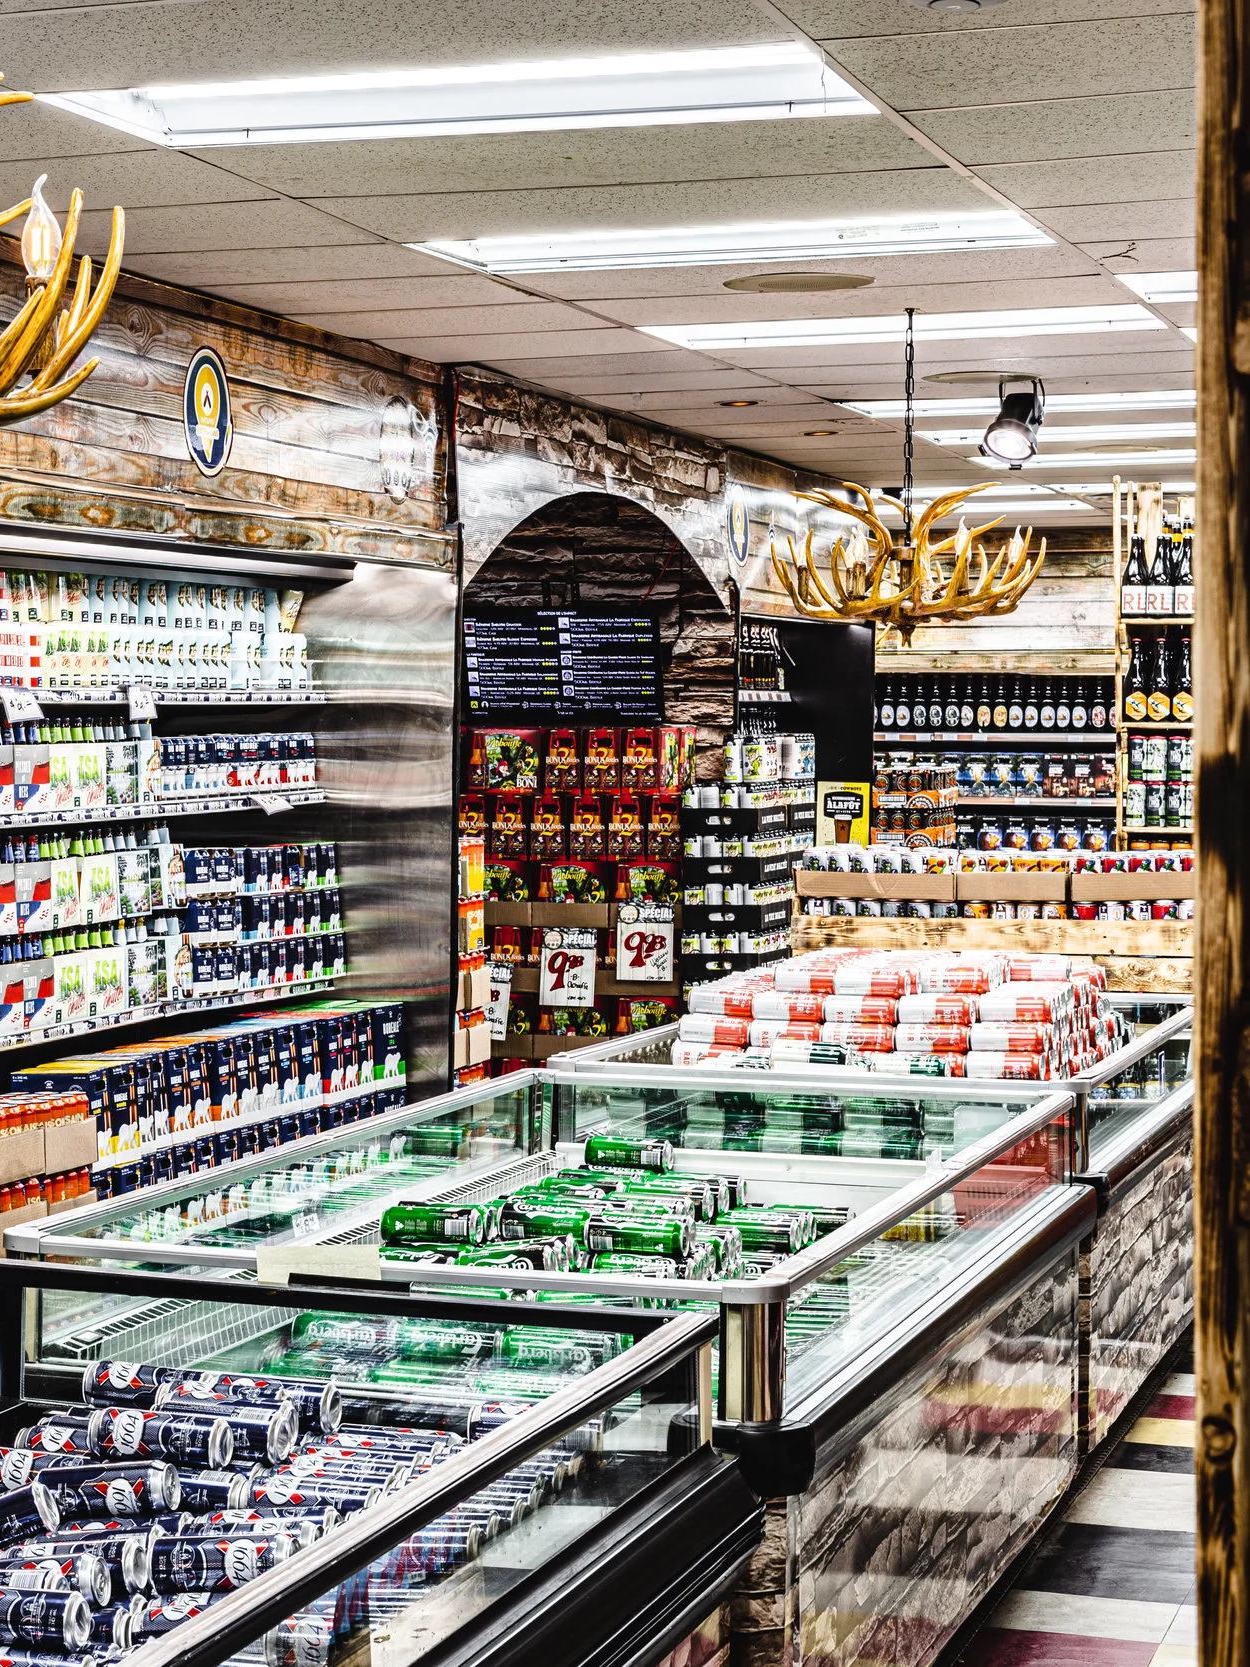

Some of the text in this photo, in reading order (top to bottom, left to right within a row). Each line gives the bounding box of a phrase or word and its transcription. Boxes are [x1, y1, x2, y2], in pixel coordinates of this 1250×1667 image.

[638, 907, 674, 920] SPÉCIAL
[563, 931, 597, 945] SPÉCIAL
[513, 1201, 576, 1216] Carlsberg
[120, 1413, 141, 1449] 1664
[6, 1450, 33, 1486] 1664
[231, 1538, 254, 1586] 1664
